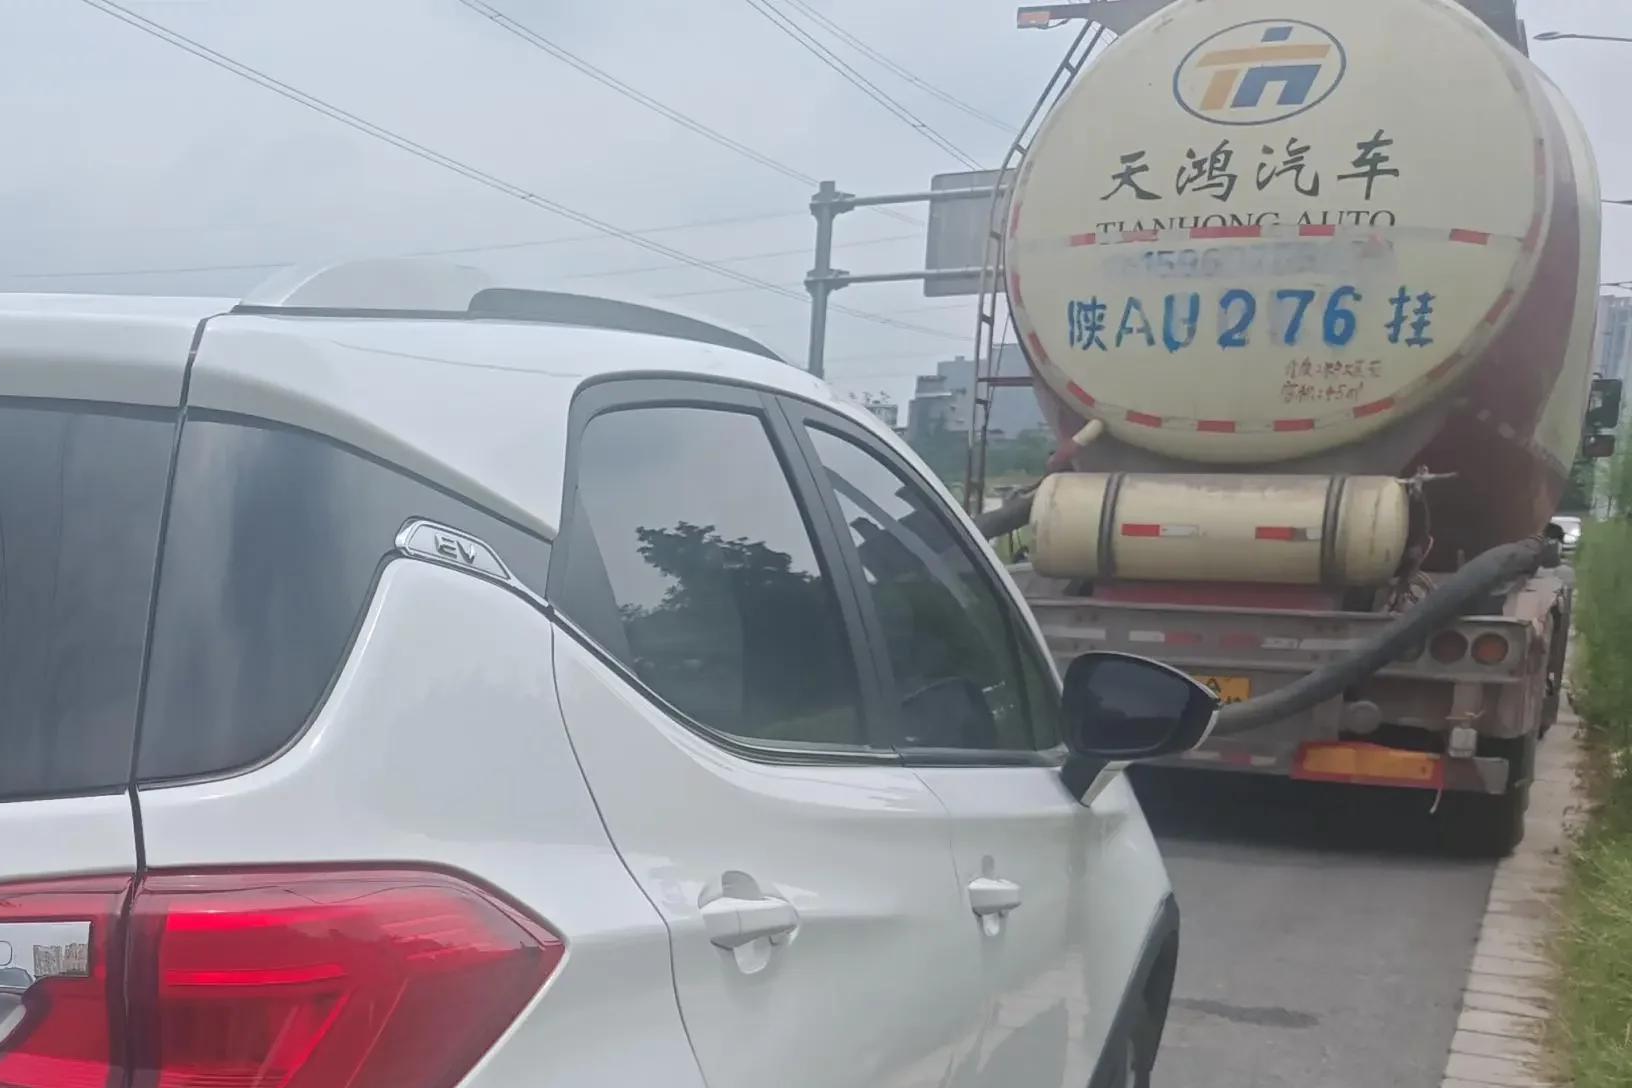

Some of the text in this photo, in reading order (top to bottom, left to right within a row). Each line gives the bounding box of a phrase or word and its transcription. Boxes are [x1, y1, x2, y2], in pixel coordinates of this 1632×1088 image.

[1100, 129, 1400, 202] 天鸿汽车
[1297, 209, 1396, 226] AUTO
[433, 531, 476, 564] EV
